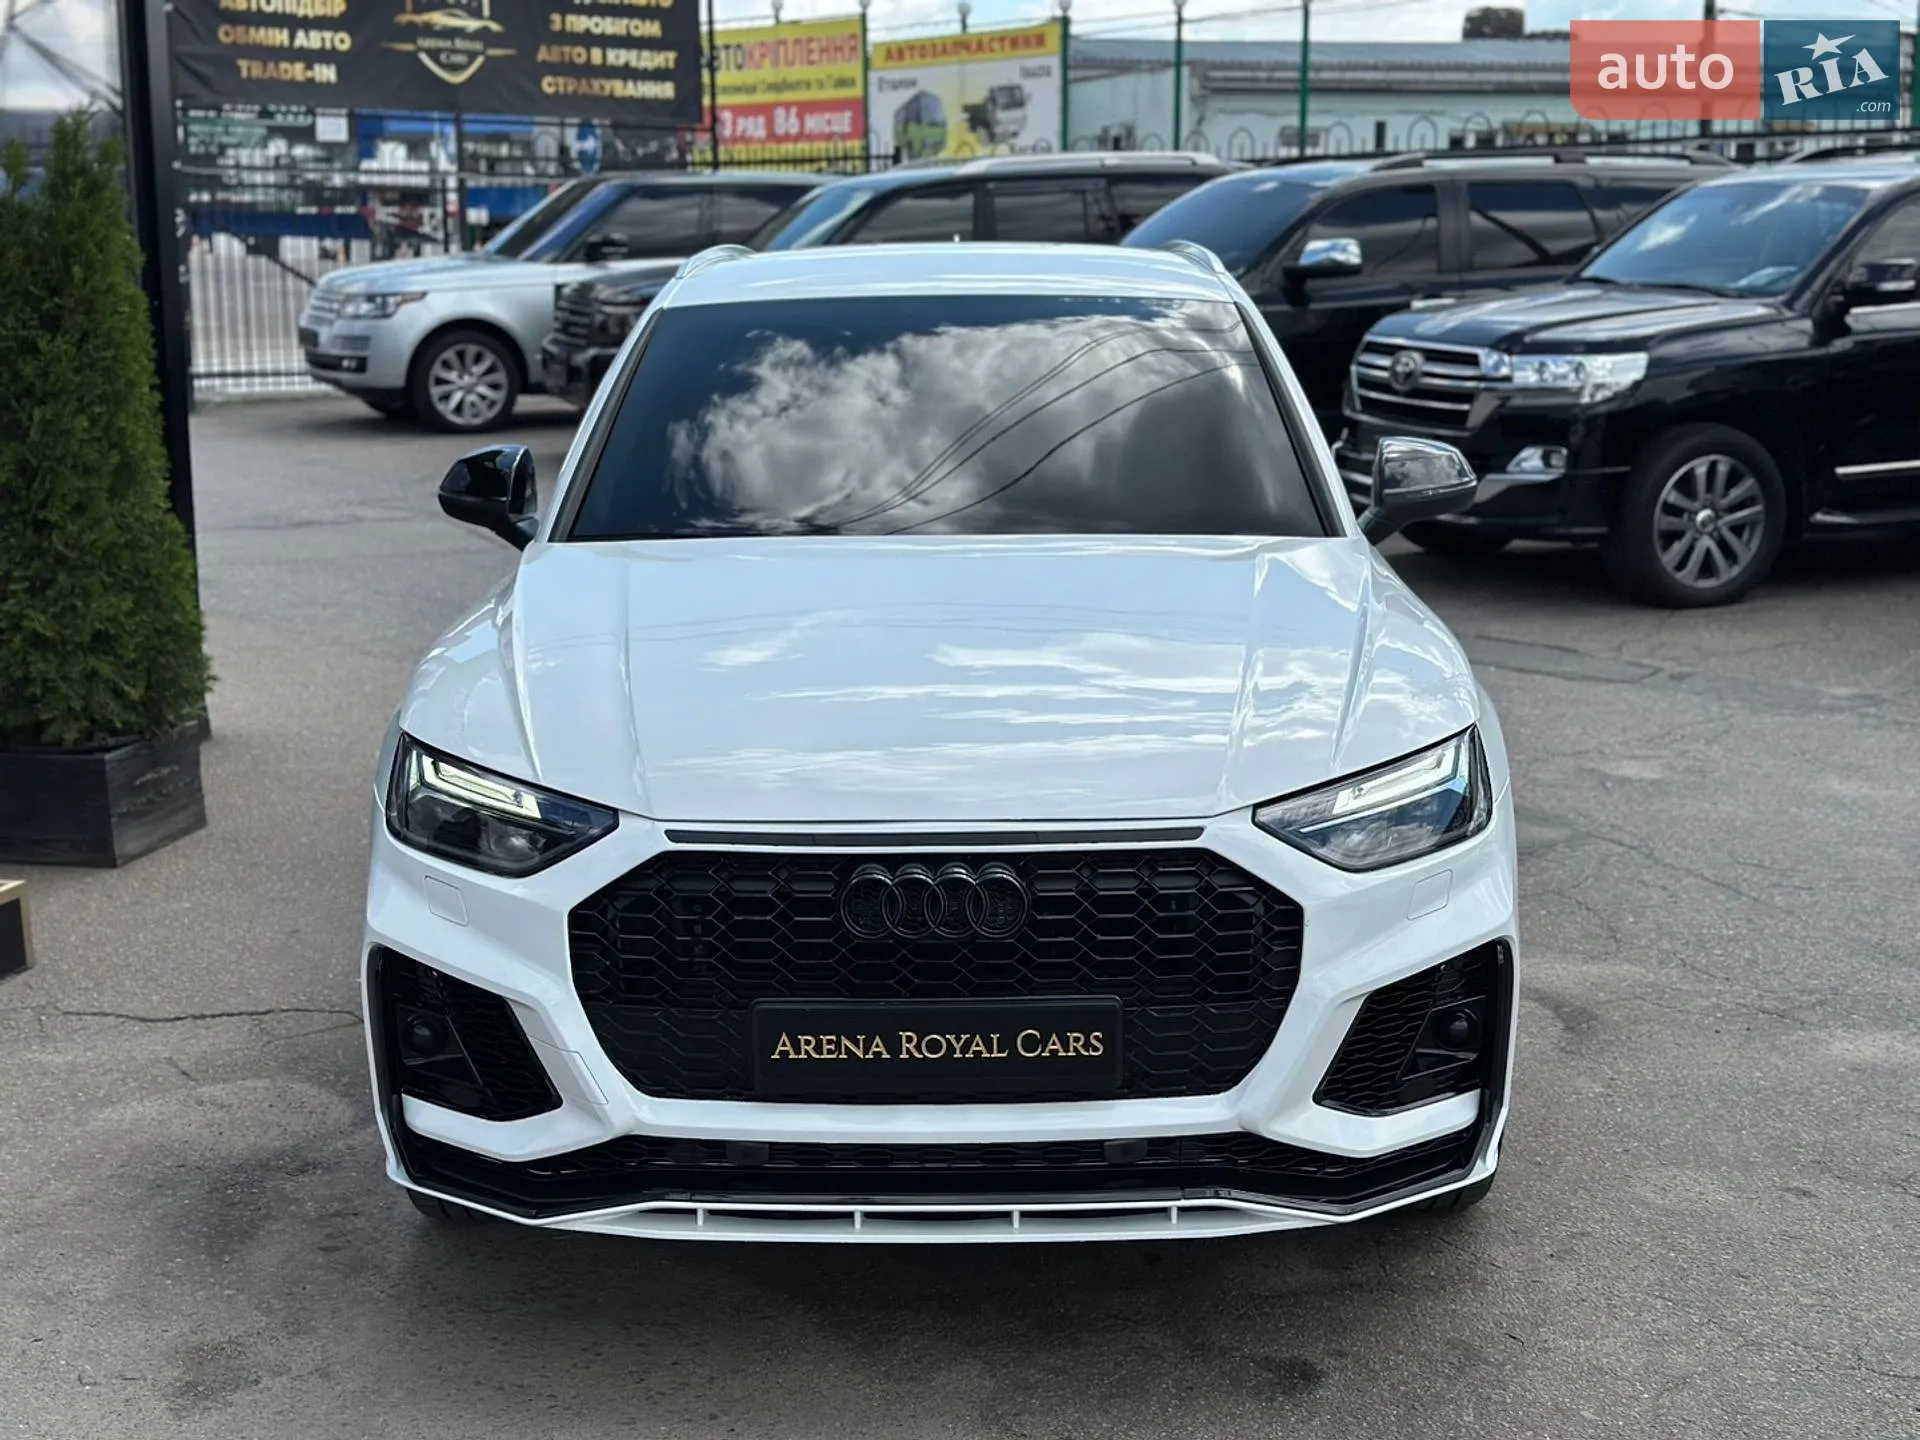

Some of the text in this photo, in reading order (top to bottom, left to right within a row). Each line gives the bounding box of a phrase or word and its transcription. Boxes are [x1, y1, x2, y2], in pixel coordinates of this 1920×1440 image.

[217, 24, 353, 52] ОБМІН АВТО
[564, 14, 662, 38] ПРОБІГОМ
[536, 44, 678, 72] АВТО В КРЕДИТ
[700, 32, 859, 71] ВТОКРІПЛЕННЯ
[884, 32, 1047, 63] АВТОЗАПЧАСТИНИ
[236, 58, 338, 85] TRADE-IN
[541, 75, 676, 100] СТРАХУВАННЯ
[771, 1028, 1104, 1060] ARENA ROYAL CARS
